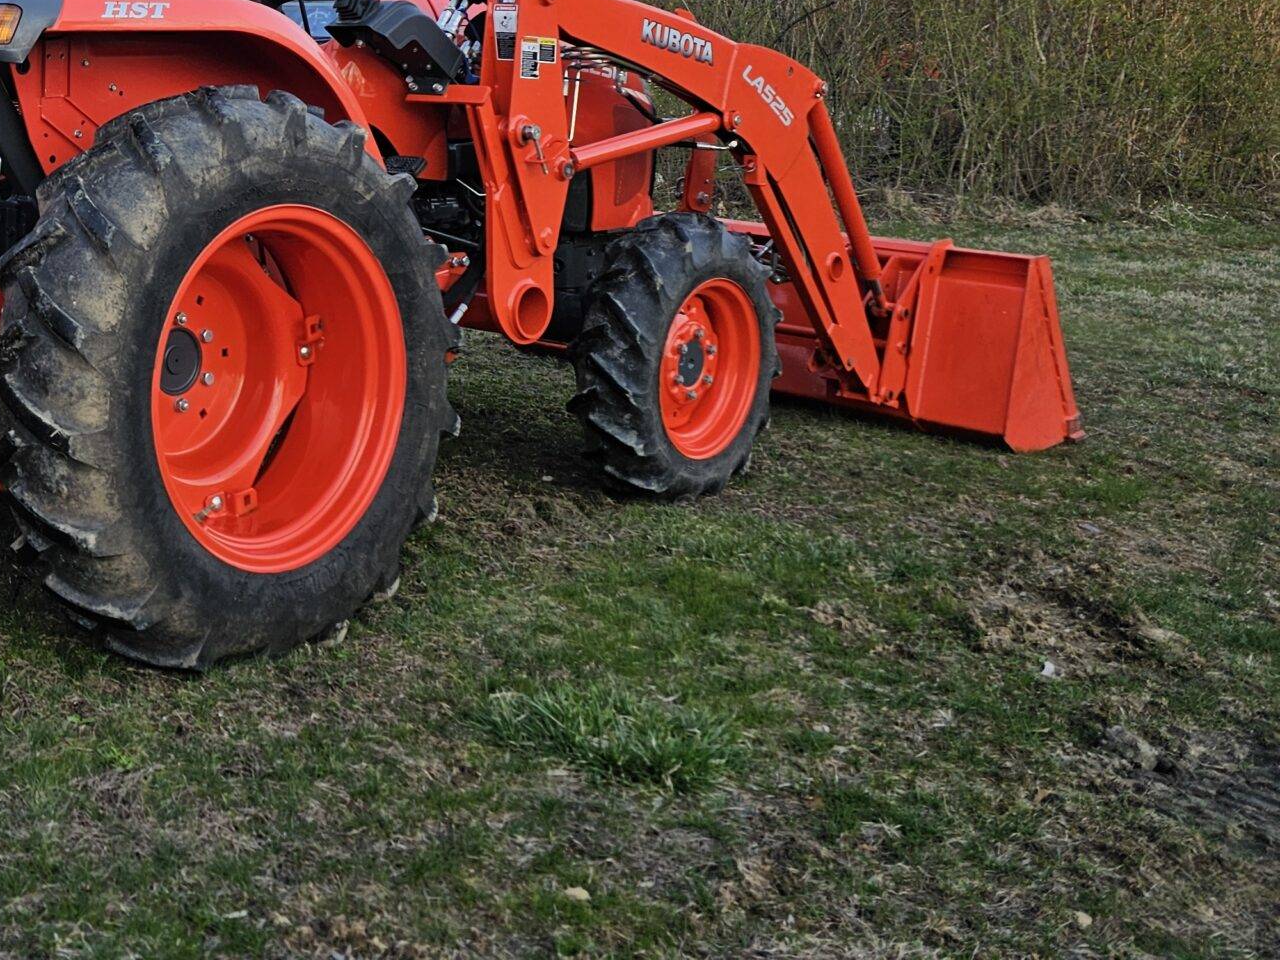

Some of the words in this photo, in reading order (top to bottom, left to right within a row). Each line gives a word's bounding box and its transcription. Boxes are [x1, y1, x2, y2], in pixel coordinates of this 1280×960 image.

[101, 0, 170, 19] HST
[641, 18, 714, 66] KUBOTA
[742, 65, 795, 127] LA525
